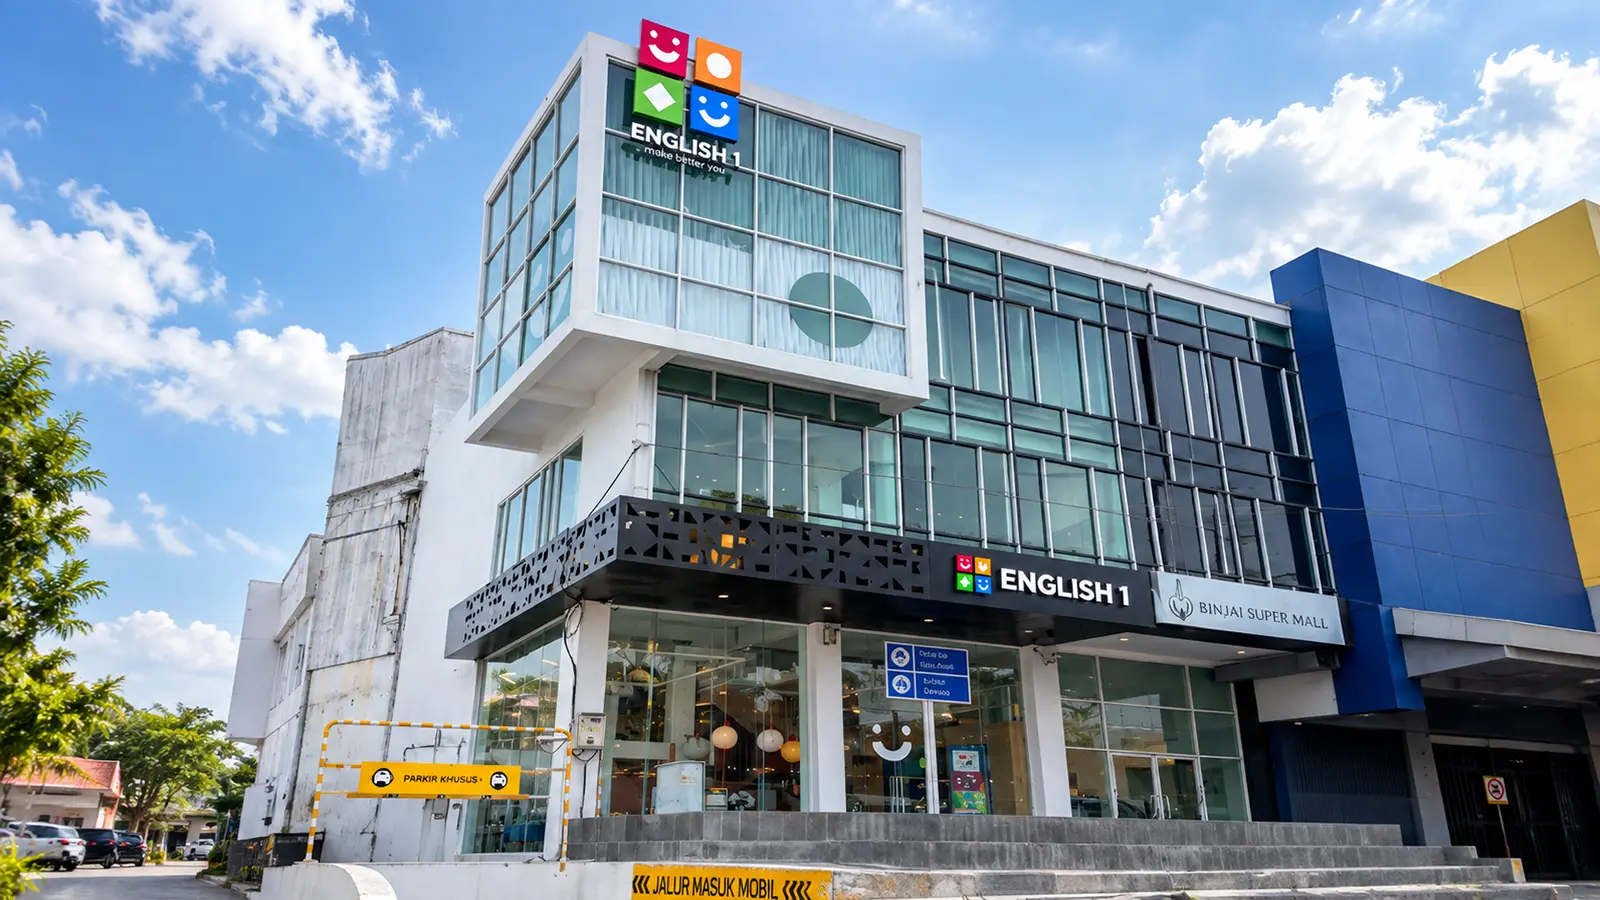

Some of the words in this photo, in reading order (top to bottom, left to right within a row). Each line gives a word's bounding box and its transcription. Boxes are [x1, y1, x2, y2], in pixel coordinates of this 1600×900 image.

[631, 122, 727, 163] ENGLISH
[732, 151, 740, 167] 1
[644, 147, 673, 160] make
[675, 153, 705, 169] better
[707, 163, 726, 175] you
[1000, 567, 1114, 605] ENGLISH
[1119, 585, 1130, 606] 1
[1199, 602, 1243, 618] BINJAI
[1247, 607, 1289, 624] SUPER
[1292, 615, 1329, 629] MALL
[404, 774, 438, 783] PARKIR
[440, 775, 478, 784] KHUSUS
[653, 875, 690, 895] JALUR
[692, 877, 735, 897] MASUK
[738, 878, 778, 900] MOBIL
